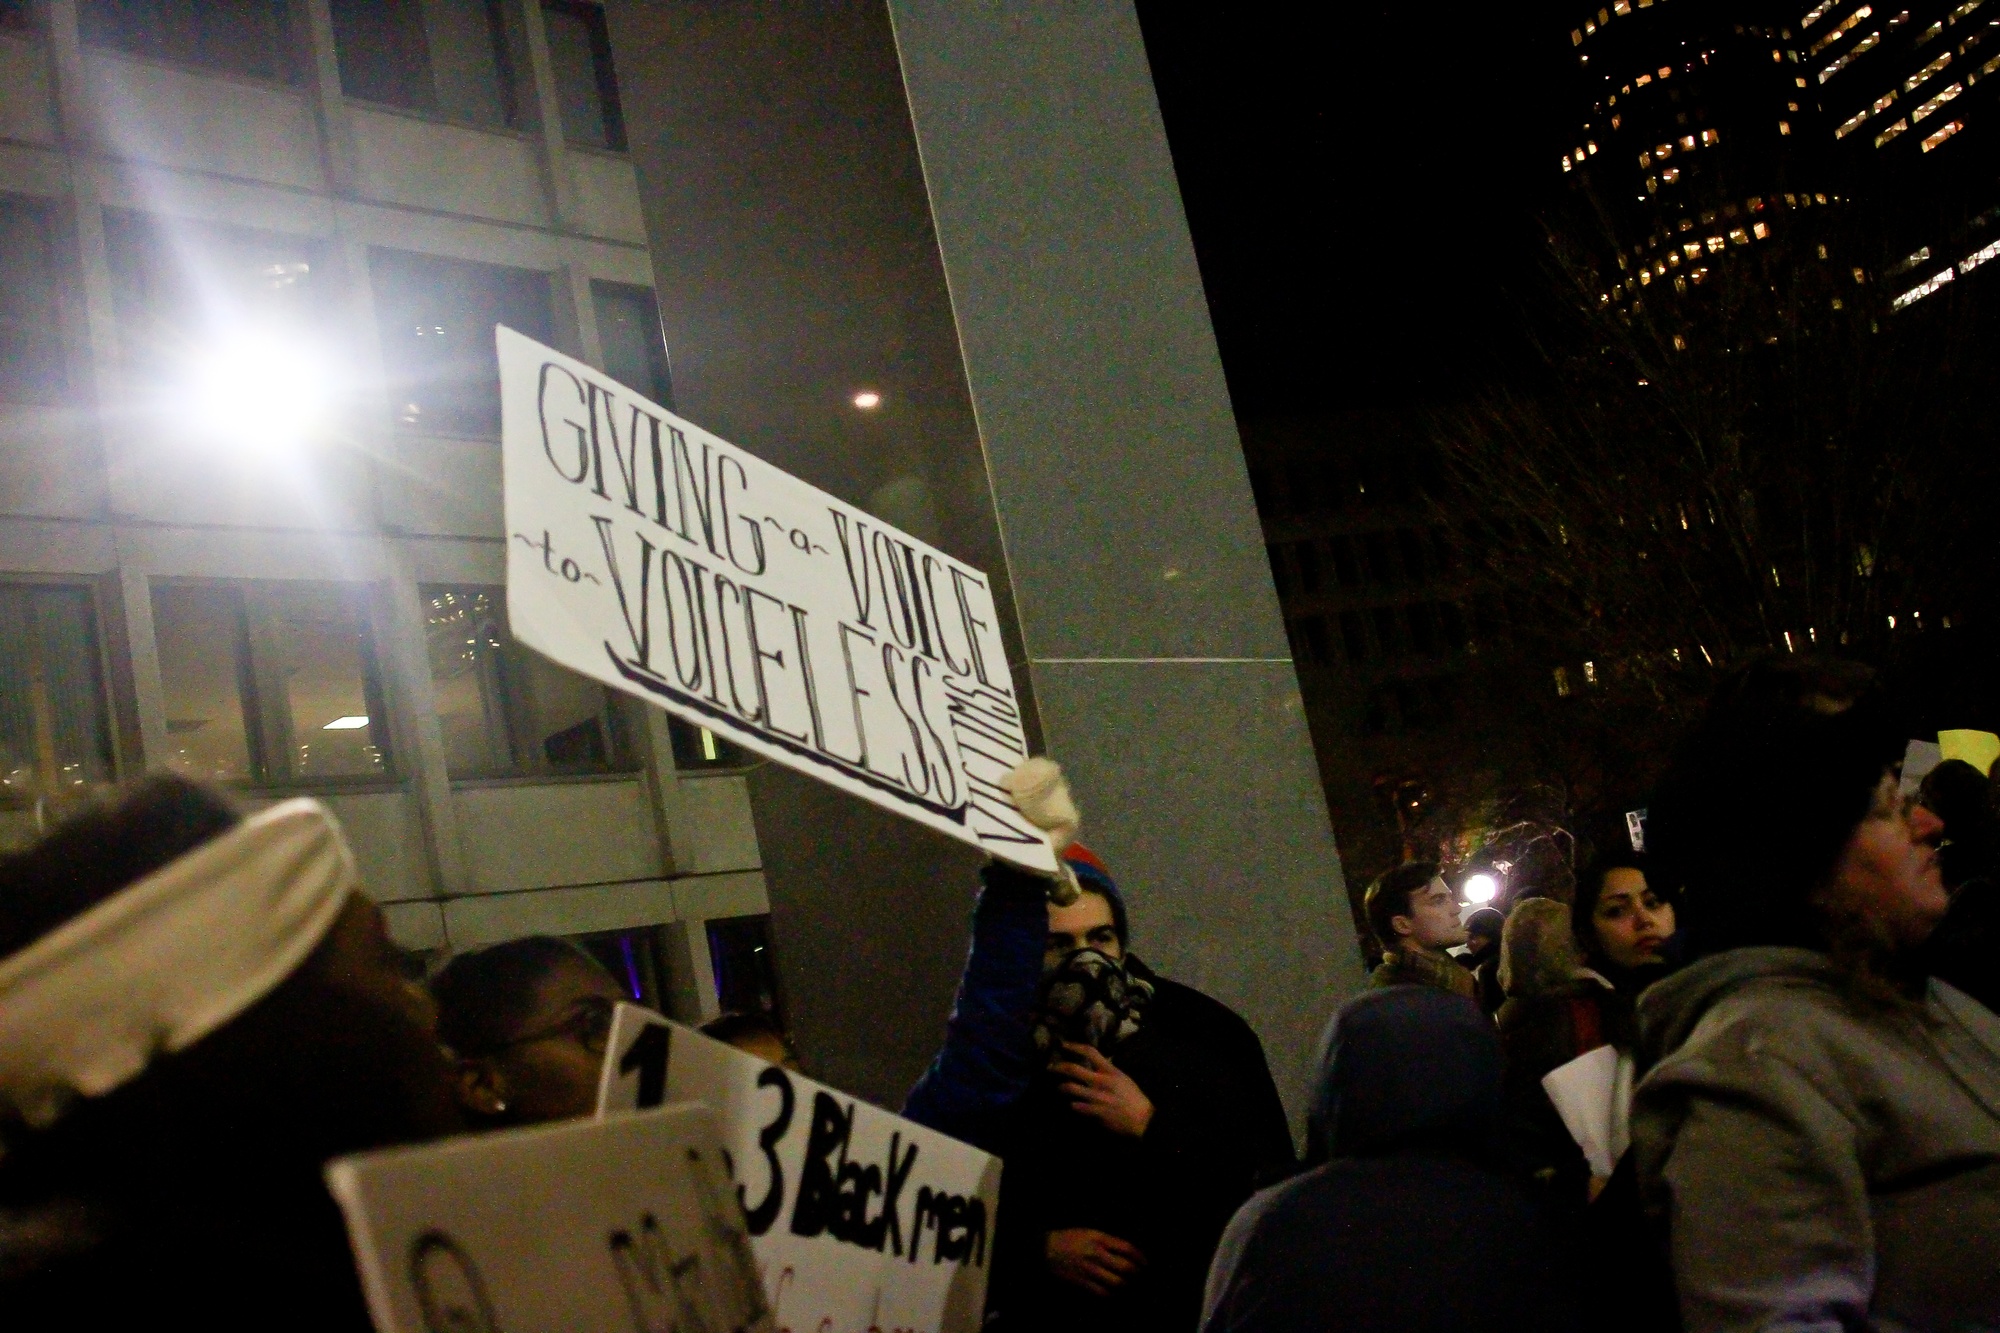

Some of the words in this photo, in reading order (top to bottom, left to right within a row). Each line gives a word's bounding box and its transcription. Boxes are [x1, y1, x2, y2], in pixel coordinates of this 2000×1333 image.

[537, 361, 766, 577] GIVING
[827, 507, 1018, 699] VOICE
[589, 514, 958, 808] VOICELESS
[942, 675, 1044, 845] VICTIMS
[619, 1022, 671, 1110] 1
[735, 1066, 795, 1237] 3
[790, 1091, 919, 1258] Black
[908, 1186, 986, 1268] men
